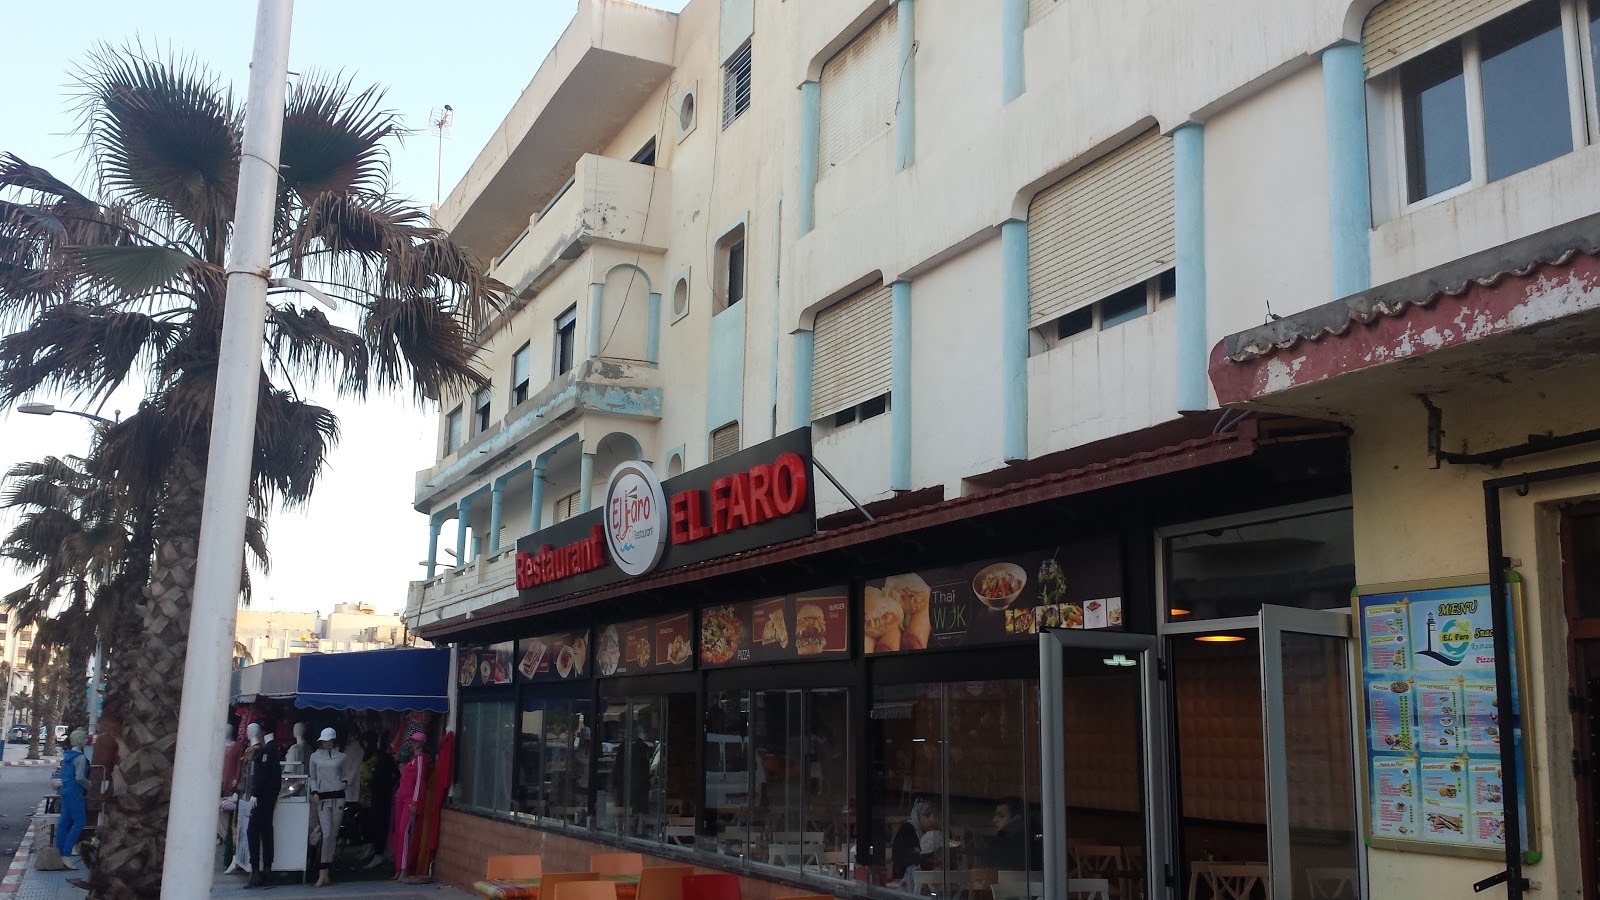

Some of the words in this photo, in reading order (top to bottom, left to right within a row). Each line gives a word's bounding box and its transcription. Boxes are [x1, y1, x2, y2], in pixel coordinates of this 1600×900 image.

[670, 490, 711, 545] EL
[710, 452, 807, 534] FARO
[515, 524, 605, 590] Restaurant
[932, 589, 956, 604] Thai
[829, 602, 845, 611] BURGER
[1438, 600, 1478, 616] MENU
[1455, 633, 1470, 641] Faro
[1474, 628, 1494, 639] Snac
[737, 649, 750, 660] PIZZA
